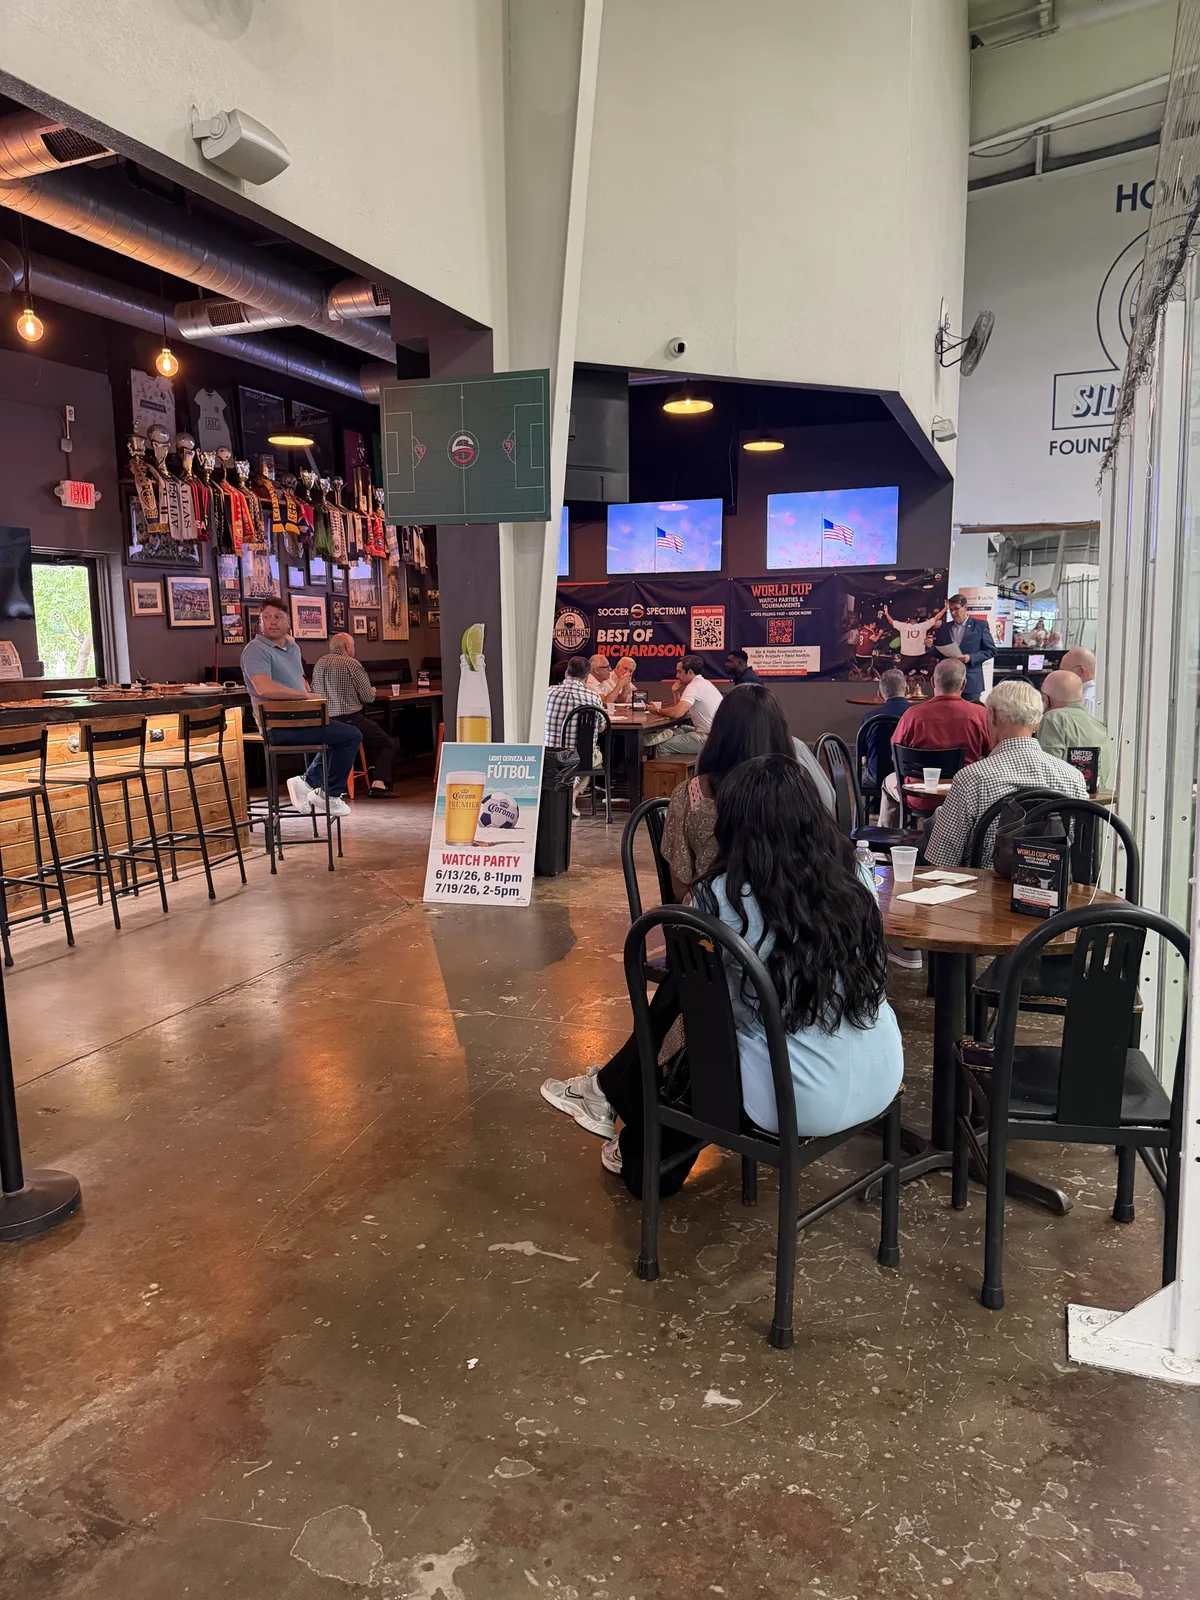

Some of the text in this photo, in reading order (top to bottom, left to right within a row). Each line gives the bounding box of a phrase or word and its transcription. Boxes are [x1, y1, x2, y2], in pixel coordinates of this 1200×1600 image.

[70, 482, 92, 504] EXIT
[751, 583, 812, 597] WORLD CUP
[598, 608, 629, 616] SOCCER
[646, 607, 686, 616] SPECTRUM
[224, 636, 244, 644] AZZURRI
[553, 629, 590, 637] ICHARDSON
[597, 629, 653, 643] BEST OF
[597, 644, 686, 657] RICHARDSON
[487, 761, 535, 779] FÚTBOL.
[452, 792, 476, 800] Corona
[487, 803, 515, 820] Corona
[1016, 848, 1035, 856] WORLD
[442, 853, 520, 867] WATCH PARTY
[435, 869, 522, 884] 6/13/26, 8-11pm
[435, 883, 520, 898] 7/19/26, 2-5pm
